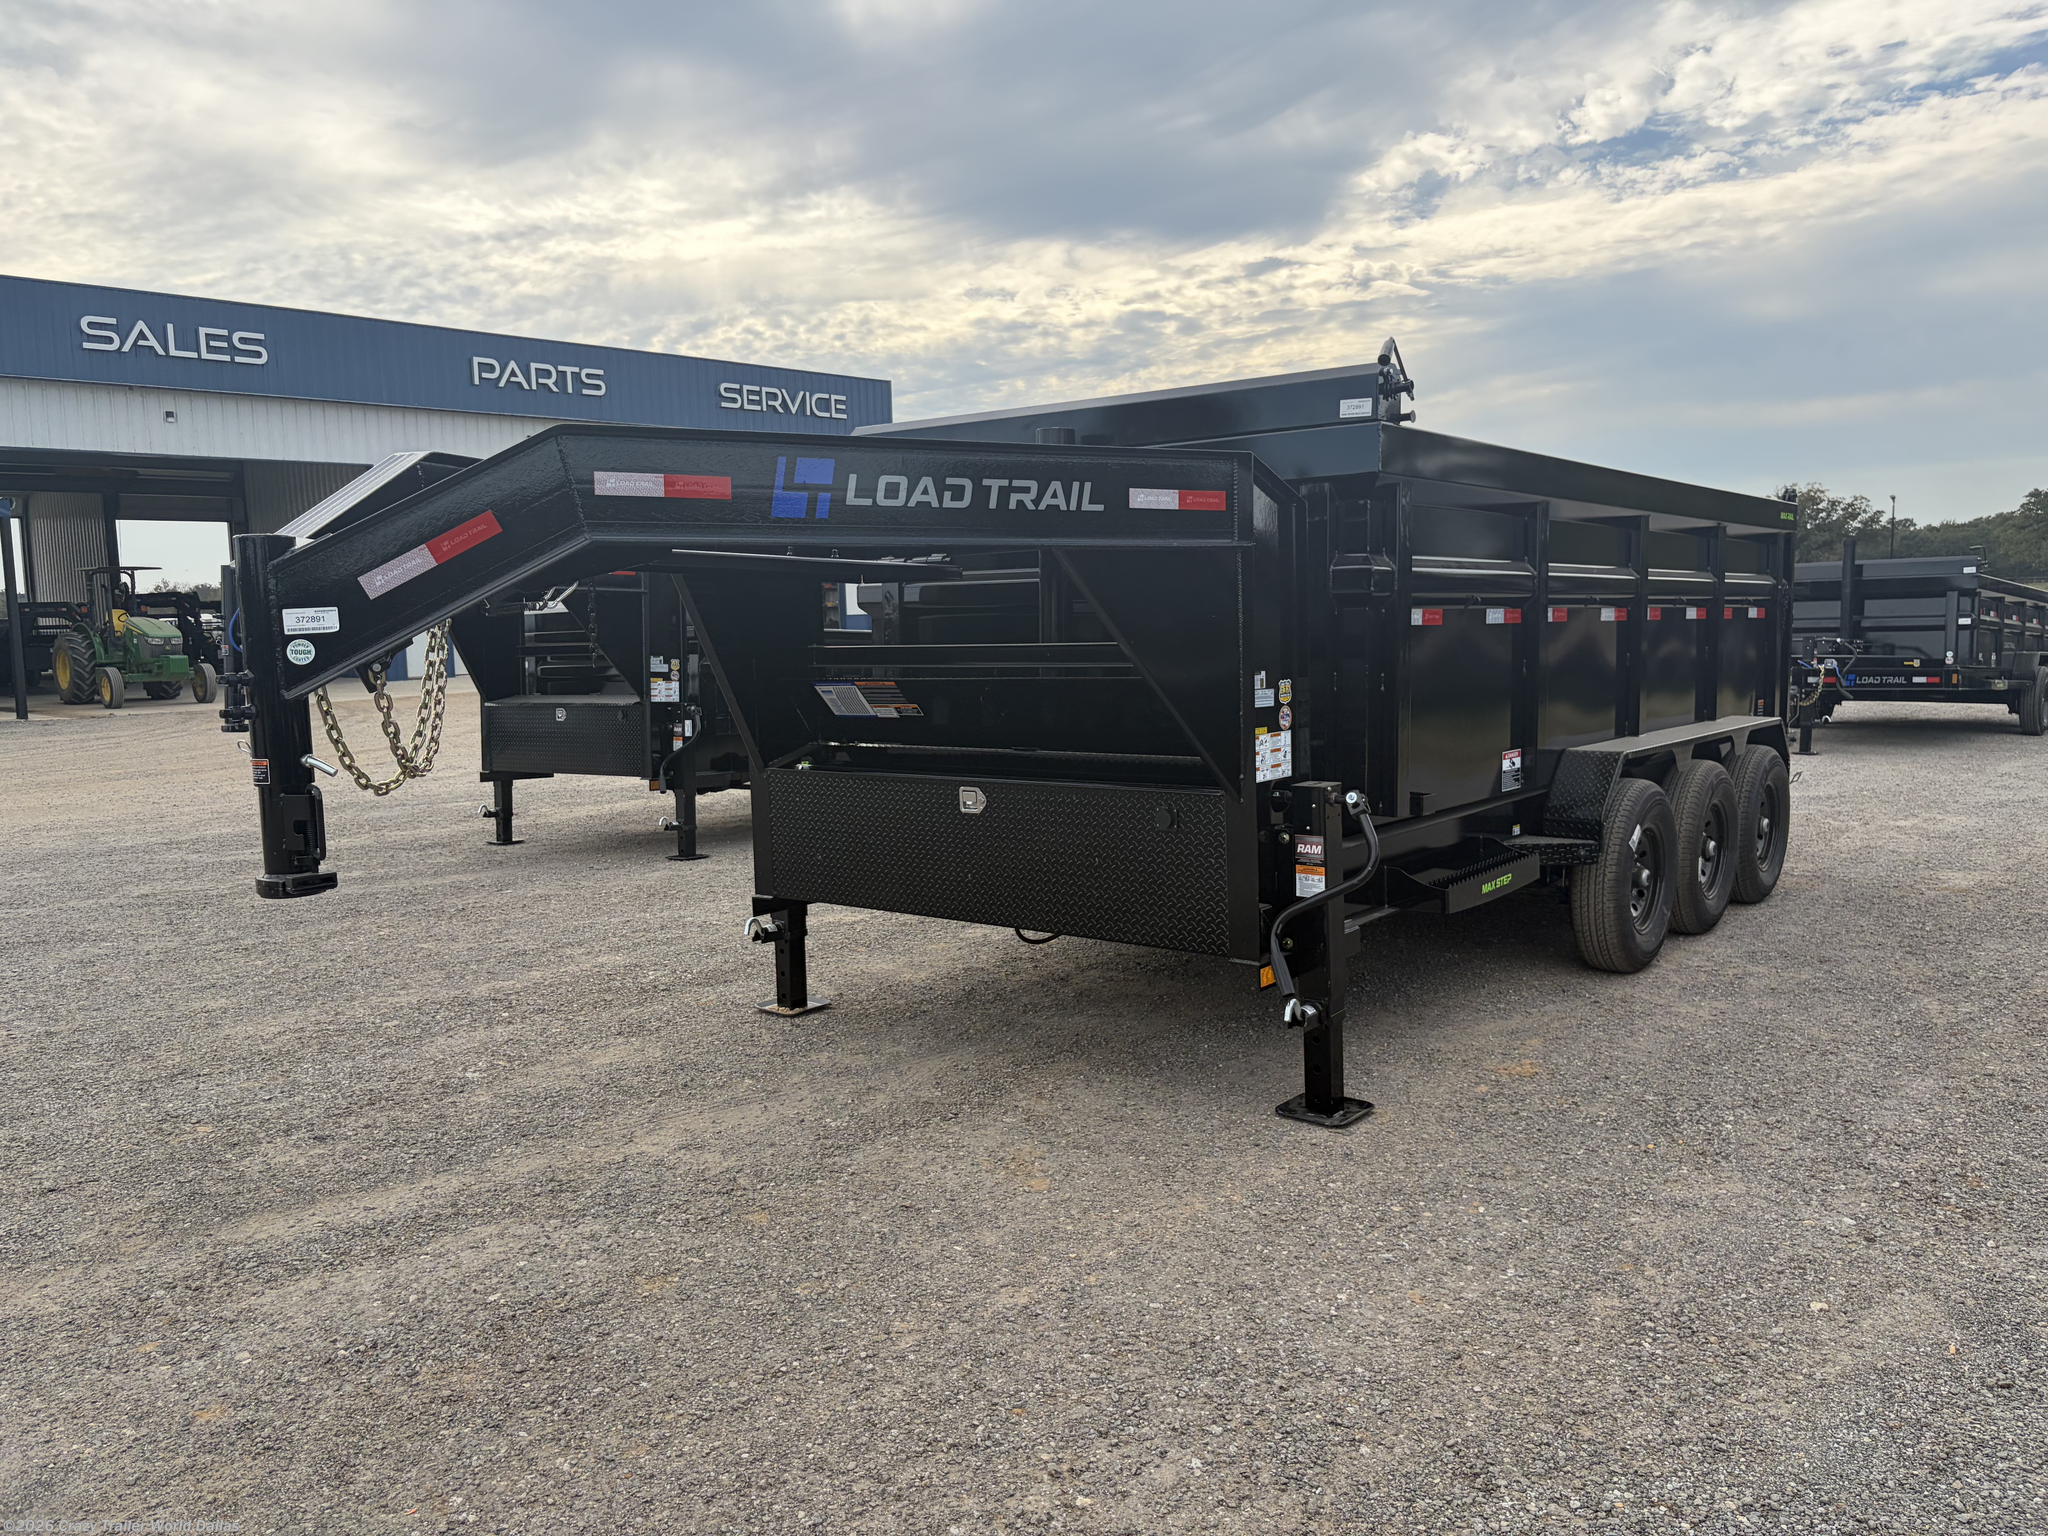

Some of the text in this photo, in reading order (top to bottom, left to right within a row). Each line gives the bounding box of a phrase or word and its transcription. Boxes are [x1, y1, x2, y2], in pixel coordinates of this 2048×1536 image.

[80, 315, 269, 365] SALES
[472, 356, 607, 396] PARTS
[719, 382, 848, 420] SERVICE
[845, 473, 1105, 512] LOAD TRAIL
[450, 523, 488, 546] LOAD TRAIL
[295, 615, 326, 624] 372891
[1856, 676, 1908, 684] LOAD TRAIL
[1296, 843, 1322, 855] RAM
[1481, 873, 1513, 895] MAX STEP
